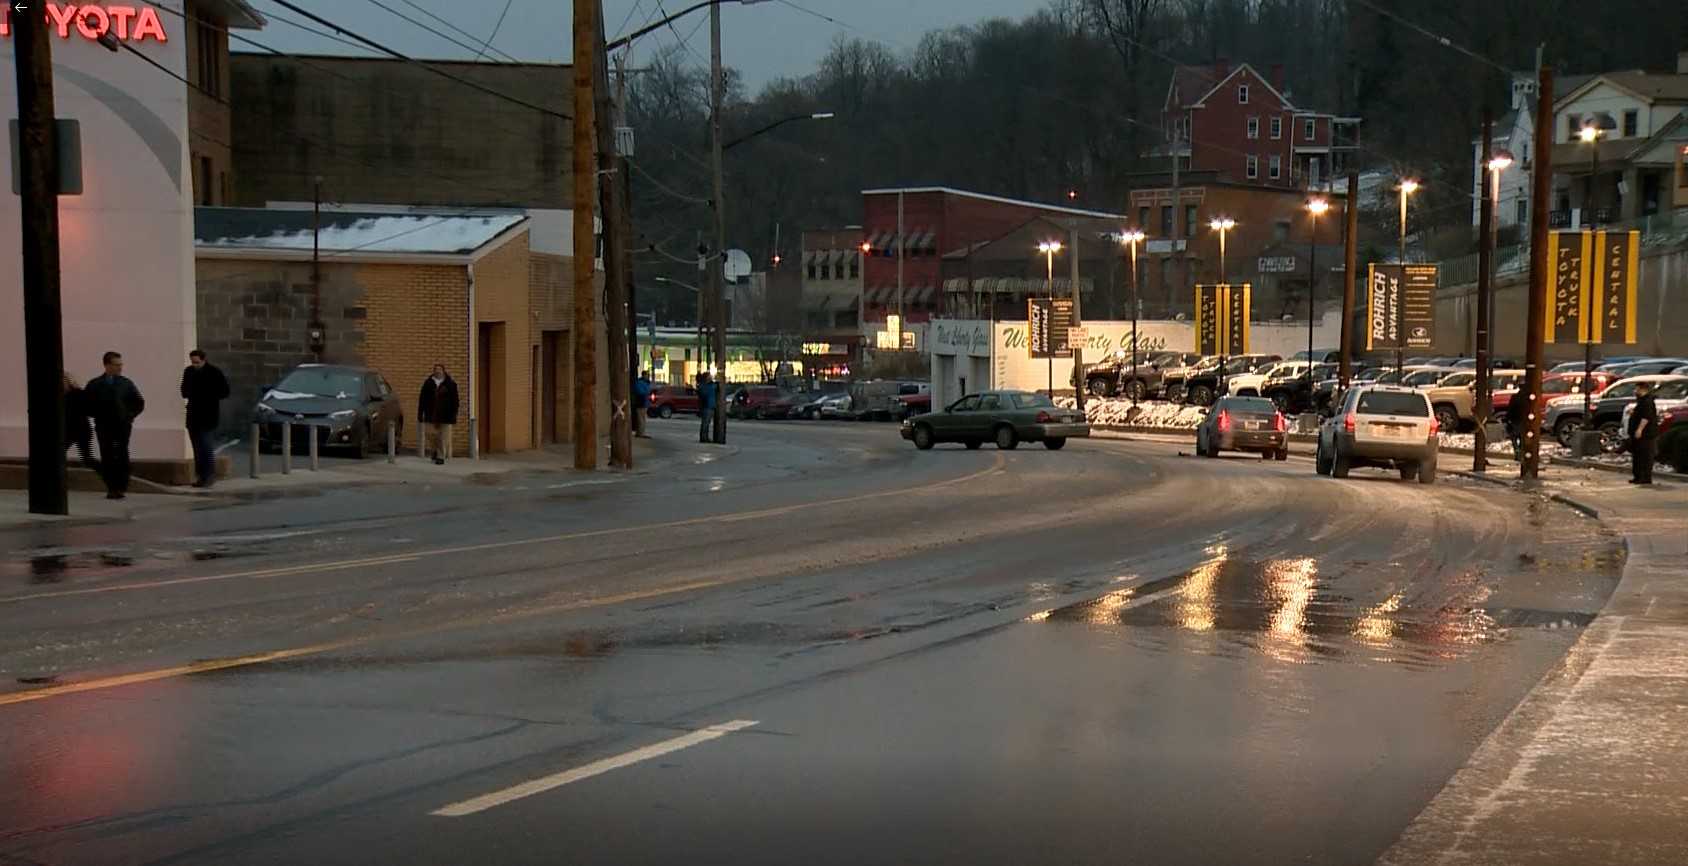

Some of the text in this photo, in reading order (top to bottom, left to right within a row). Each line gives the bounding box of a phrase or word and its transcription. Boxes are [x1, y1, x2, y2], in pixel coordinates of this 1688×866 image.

[0, 3, 168, 42] TYOTA
[1373, 271, 1386, 341] ROHRICH
[1388, 277, 1399, 341] ADVANTAGE
[1556, 248, 1570, 325] TOYOTA
[1567, 257, 1581, 317] TRUCK
[1608, 245, 1623, 329] CENTRAL
[1121, 330, 1168, 353] Glass
